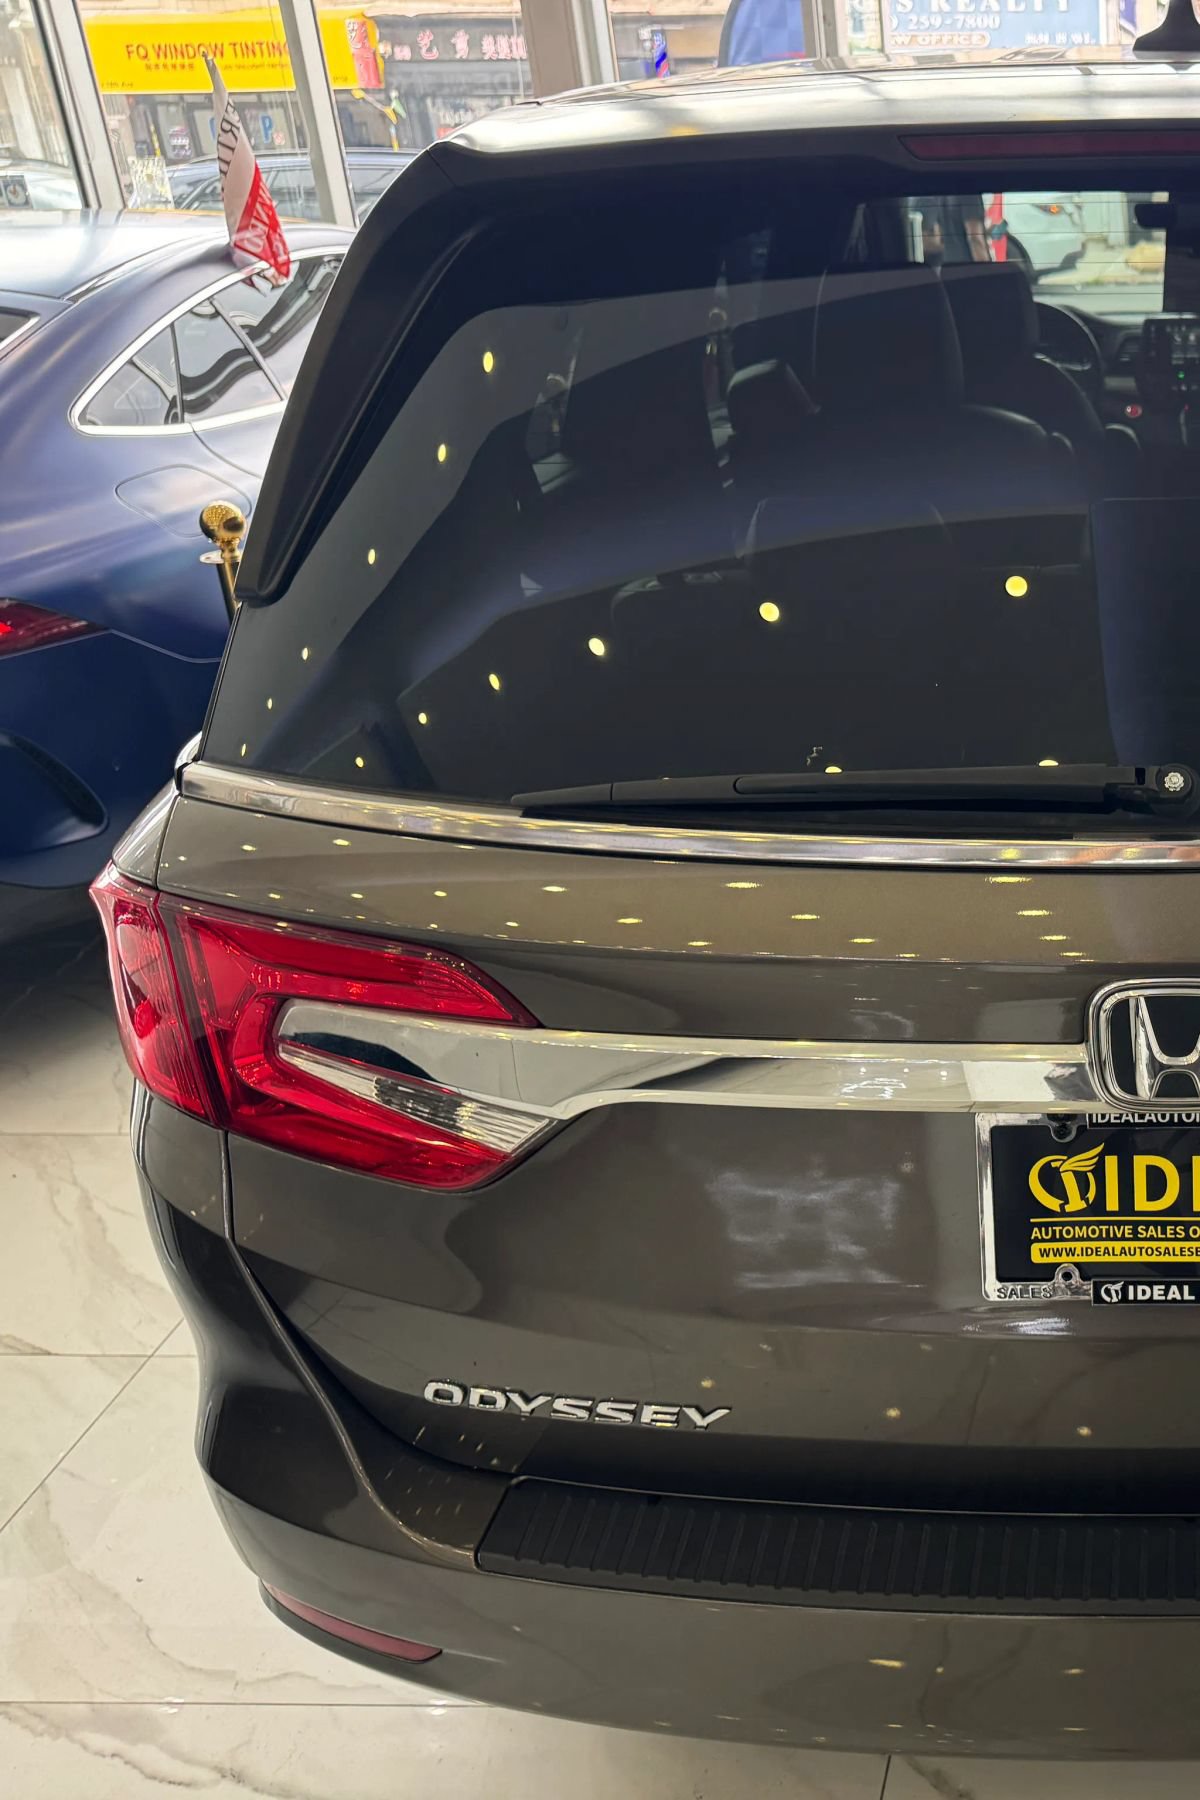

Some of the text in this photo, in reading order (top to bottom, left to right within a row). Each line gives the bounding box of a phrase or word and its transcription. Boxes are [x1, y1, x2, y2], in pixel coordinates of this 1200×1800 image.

[919, 34, 984, 46] OFFICE
[152, 42, 225, 60] WINDOW
[1030, 1225, 1133, 1240] AUTOMOTIVE
[1137, 1225, 1186, 1239] SALES
[996, 1286, 1053, 1300] SALES
[1128, 1284, 1197, 1301] IDEAL
[423, 1377, 732, 1430] ODYSSEY
